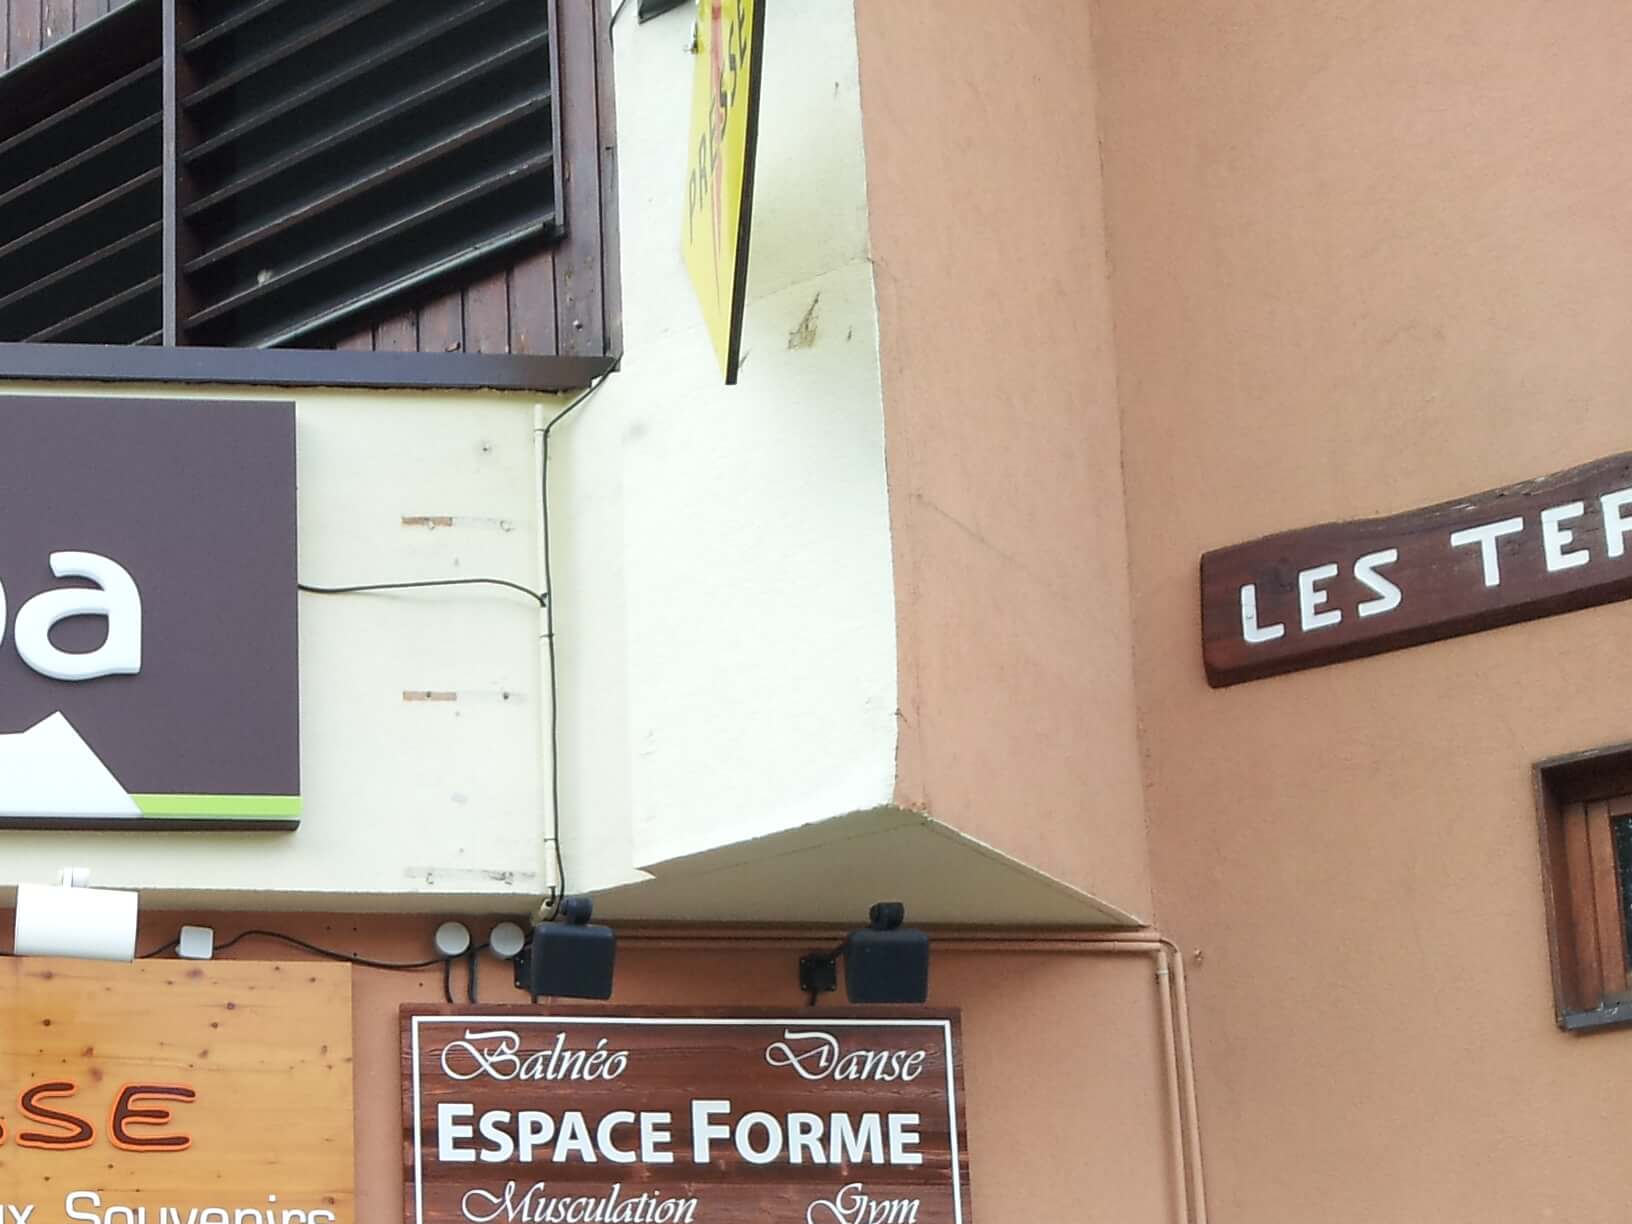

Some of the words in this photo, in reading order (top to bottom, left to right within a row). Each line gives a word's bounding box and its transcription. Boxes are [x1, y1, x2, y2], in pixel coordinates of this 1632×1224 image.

[1239, 549, 1403, 645] LES
[441, 1028, 629, 1082] Balnéo
[765, 1028, 926, 1083] Danse
[438, 1103, 674, 1163] ESPACE
[691, 1100, 924, 1165] FORME
[461, 1180, 699, 1224] Musculation
